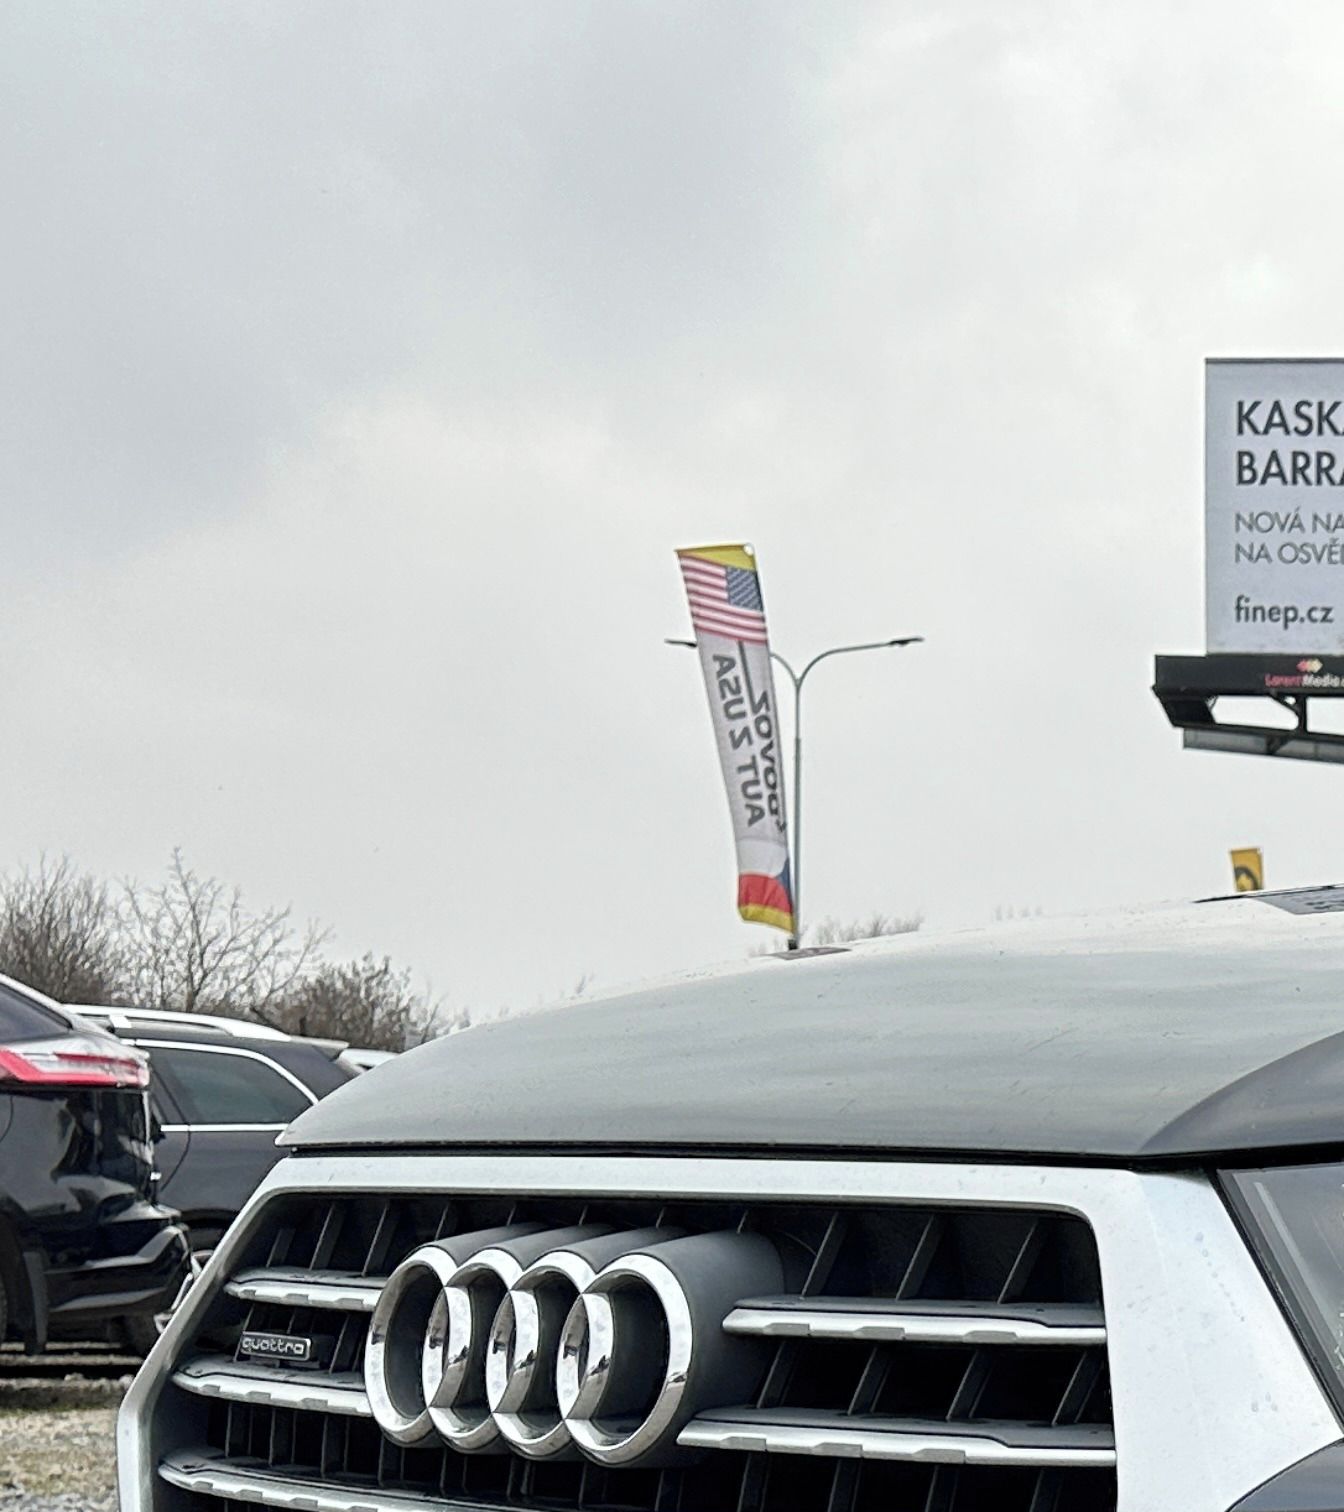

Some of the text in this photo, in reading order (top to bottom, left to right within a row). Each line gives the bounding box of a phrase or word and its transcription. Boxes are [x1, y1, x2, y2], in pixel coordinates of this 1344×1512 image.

[1235, 506, 1305, 535] NOVÁ
[1235, 543, 1275, 564] NA
[1235, 595, 1334, 631] finep.cz
[242, 1337, 304, 1354] quattro
